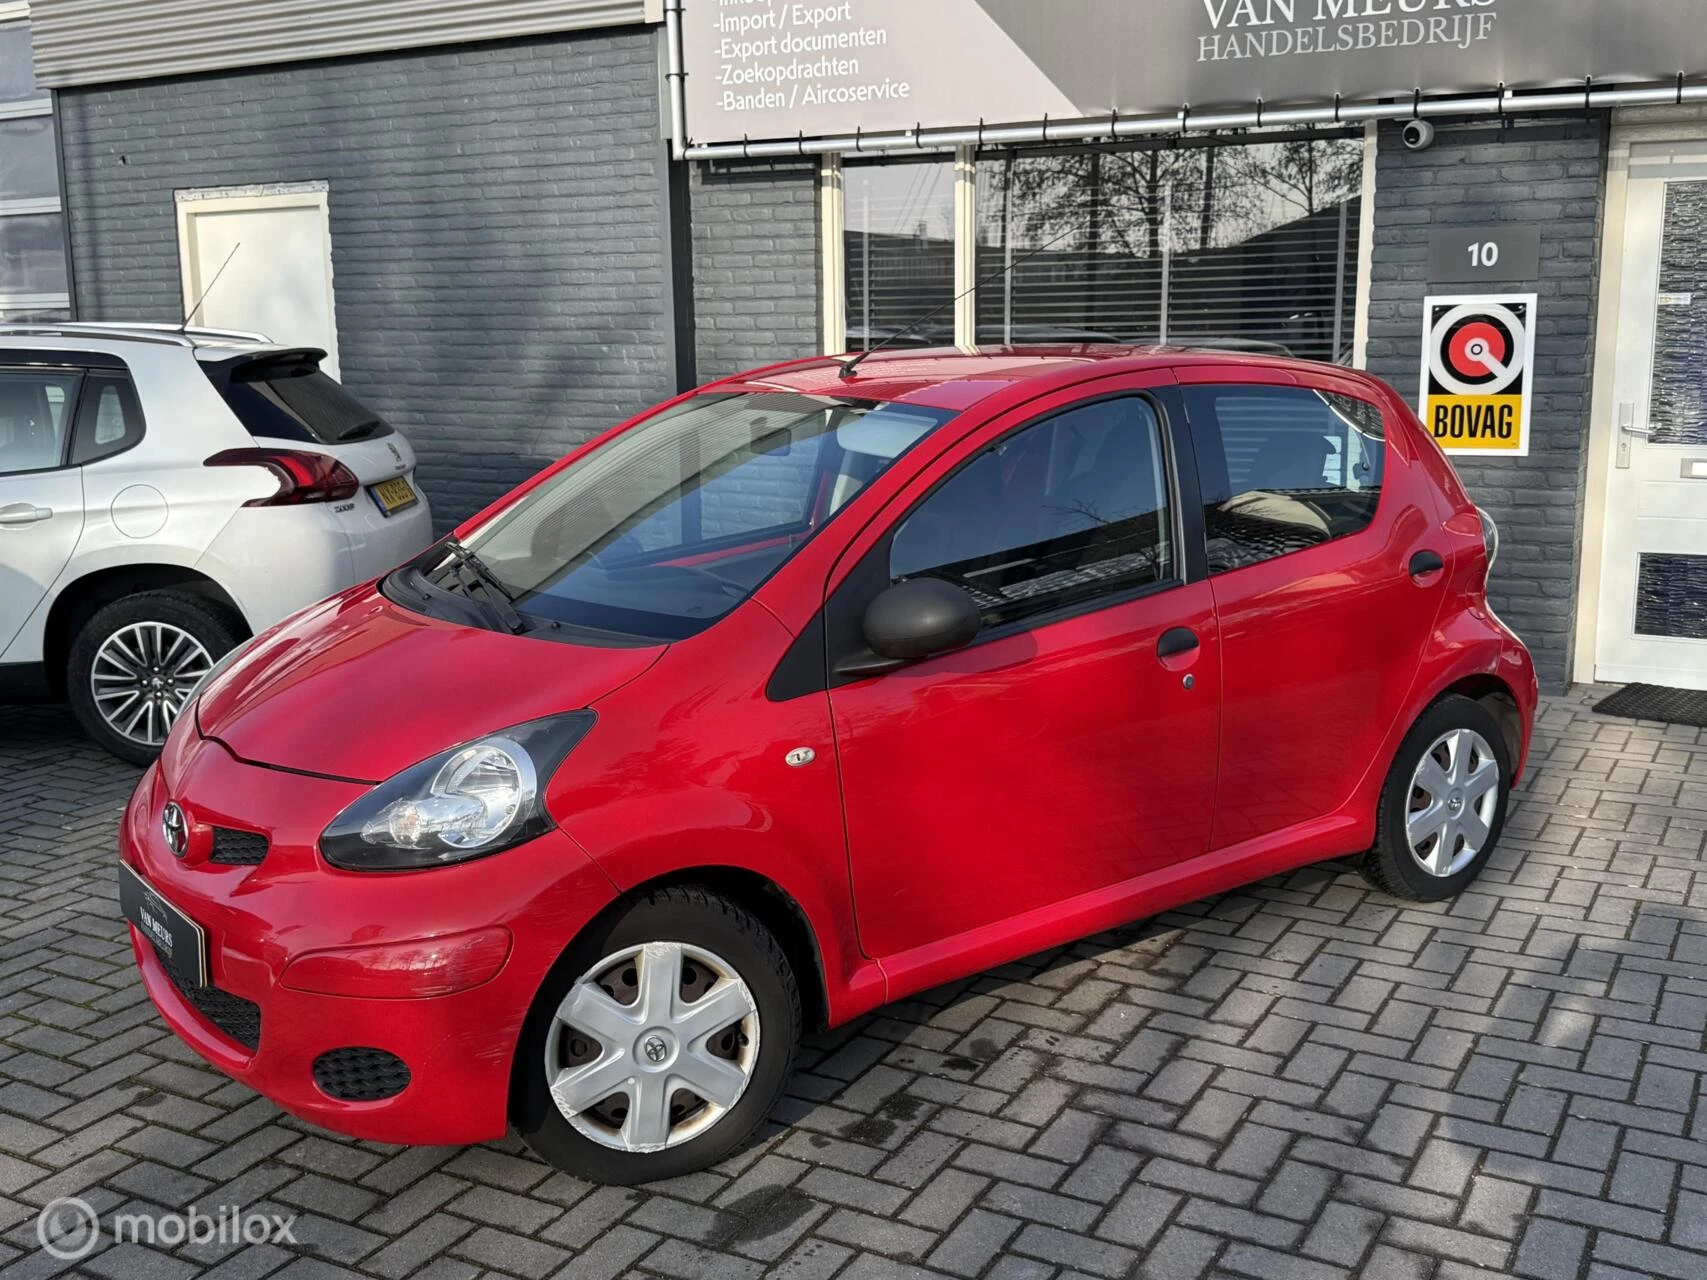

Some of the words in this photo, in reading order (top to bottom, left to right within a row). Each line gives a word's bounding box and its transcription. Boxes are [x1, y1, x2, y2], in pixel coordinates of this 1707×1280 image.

[712, 10, 776, 36] -Import
[792, 3, 852, 29] Export
[714, 36, 778, 62] -Export
[780, 27, 887, 54] documenten
[1196, 12, 1497, 62] HANDELSBEDRIJF
[715, 55, 859, 86] -Zoekopdrachten
[716, 88, 786, 111] -Banden
[802, 77, 910, 106] Aircoservice
[1467, 241, 1499, 267] 10
[1434, 404, 1514, 439] BOVAG
